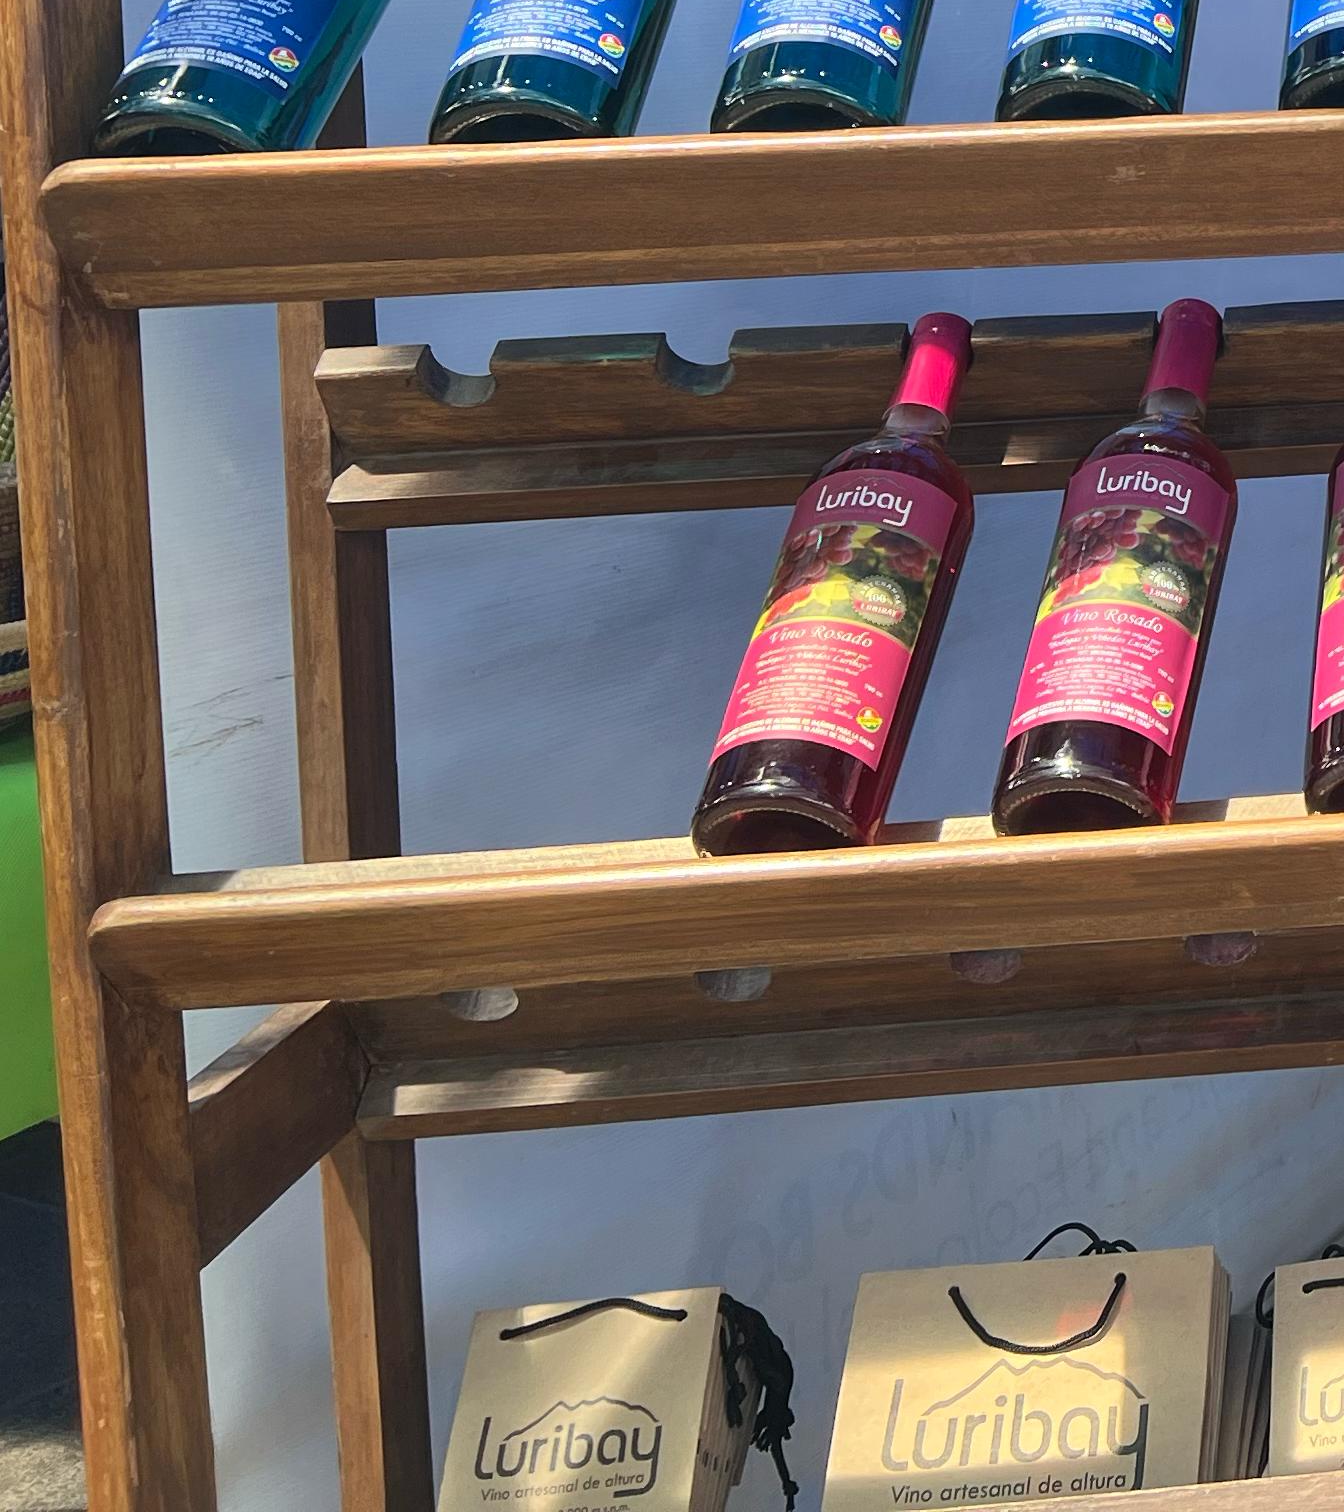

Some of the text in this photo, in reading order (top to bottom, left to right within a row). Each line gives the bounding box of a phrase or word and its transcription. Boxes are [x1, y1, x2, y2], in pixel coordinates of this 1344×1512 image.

[815, 484, 913, 527] Luribay
[1096, 467, 1192, 514] Luribay
[769, 625, 873, 648] Vino Rosado
[1062, 608, 1164, 634] Vino Rosado
[881, 1379, 1149, 1491] Luribay
[1308, 1435, 1337, 1448] Vino
[474, 1417, 662, 1498] Luribay
[481, 1472, 644, 1501] Vino artesanal de altura
[892, 1472, 1126, 1504] Vino artesanal de altura
